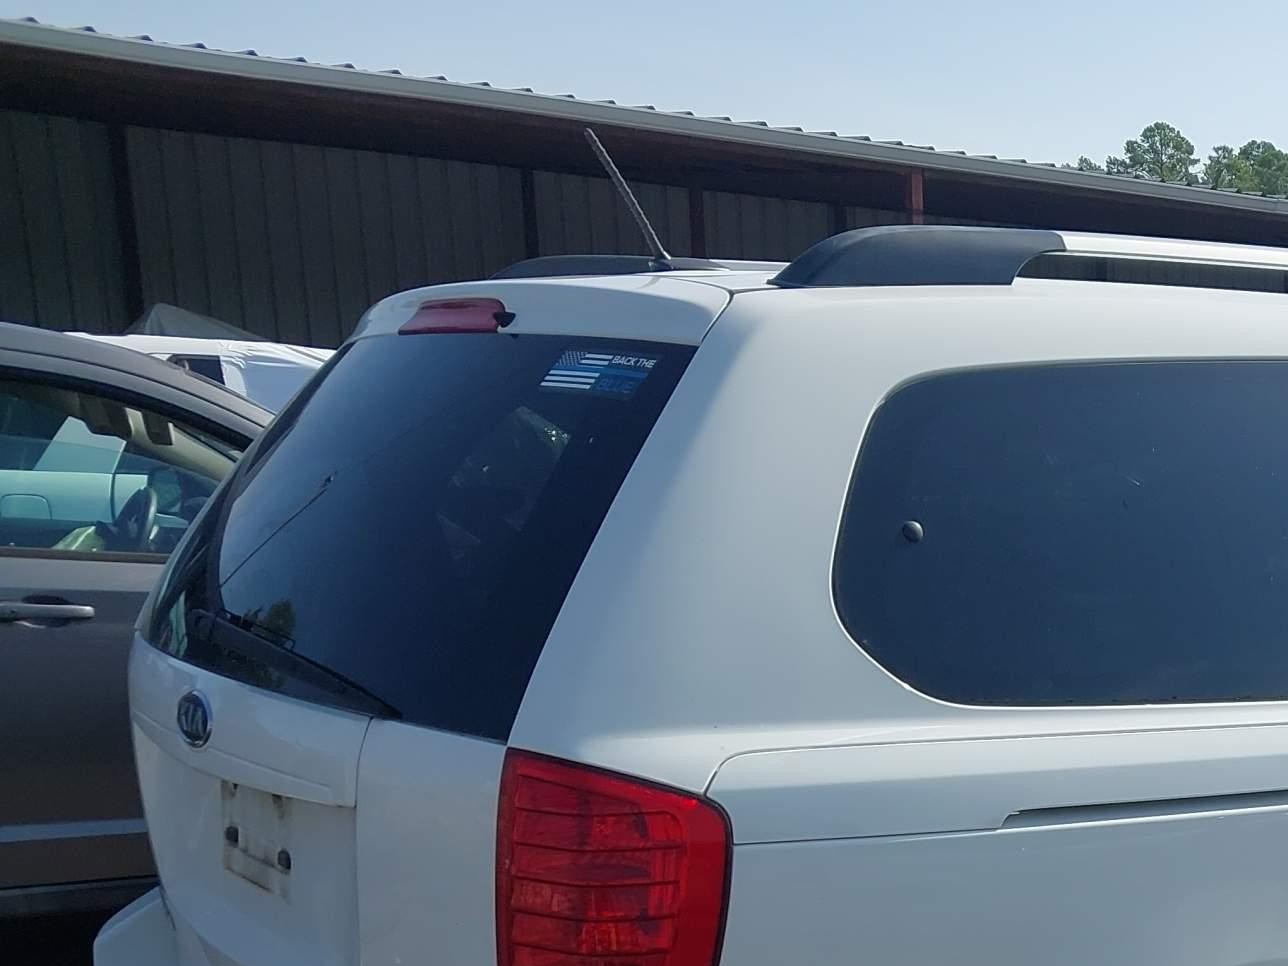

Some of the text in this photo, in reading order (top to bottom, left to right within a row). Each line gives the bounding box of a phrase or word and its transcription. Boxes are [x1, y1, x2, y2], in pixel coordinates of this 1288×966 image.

[611, 355, 657, 369] BACK THE
[596, 378, 633, 394] BLUE
[180, 702, 205, 737] KIA
